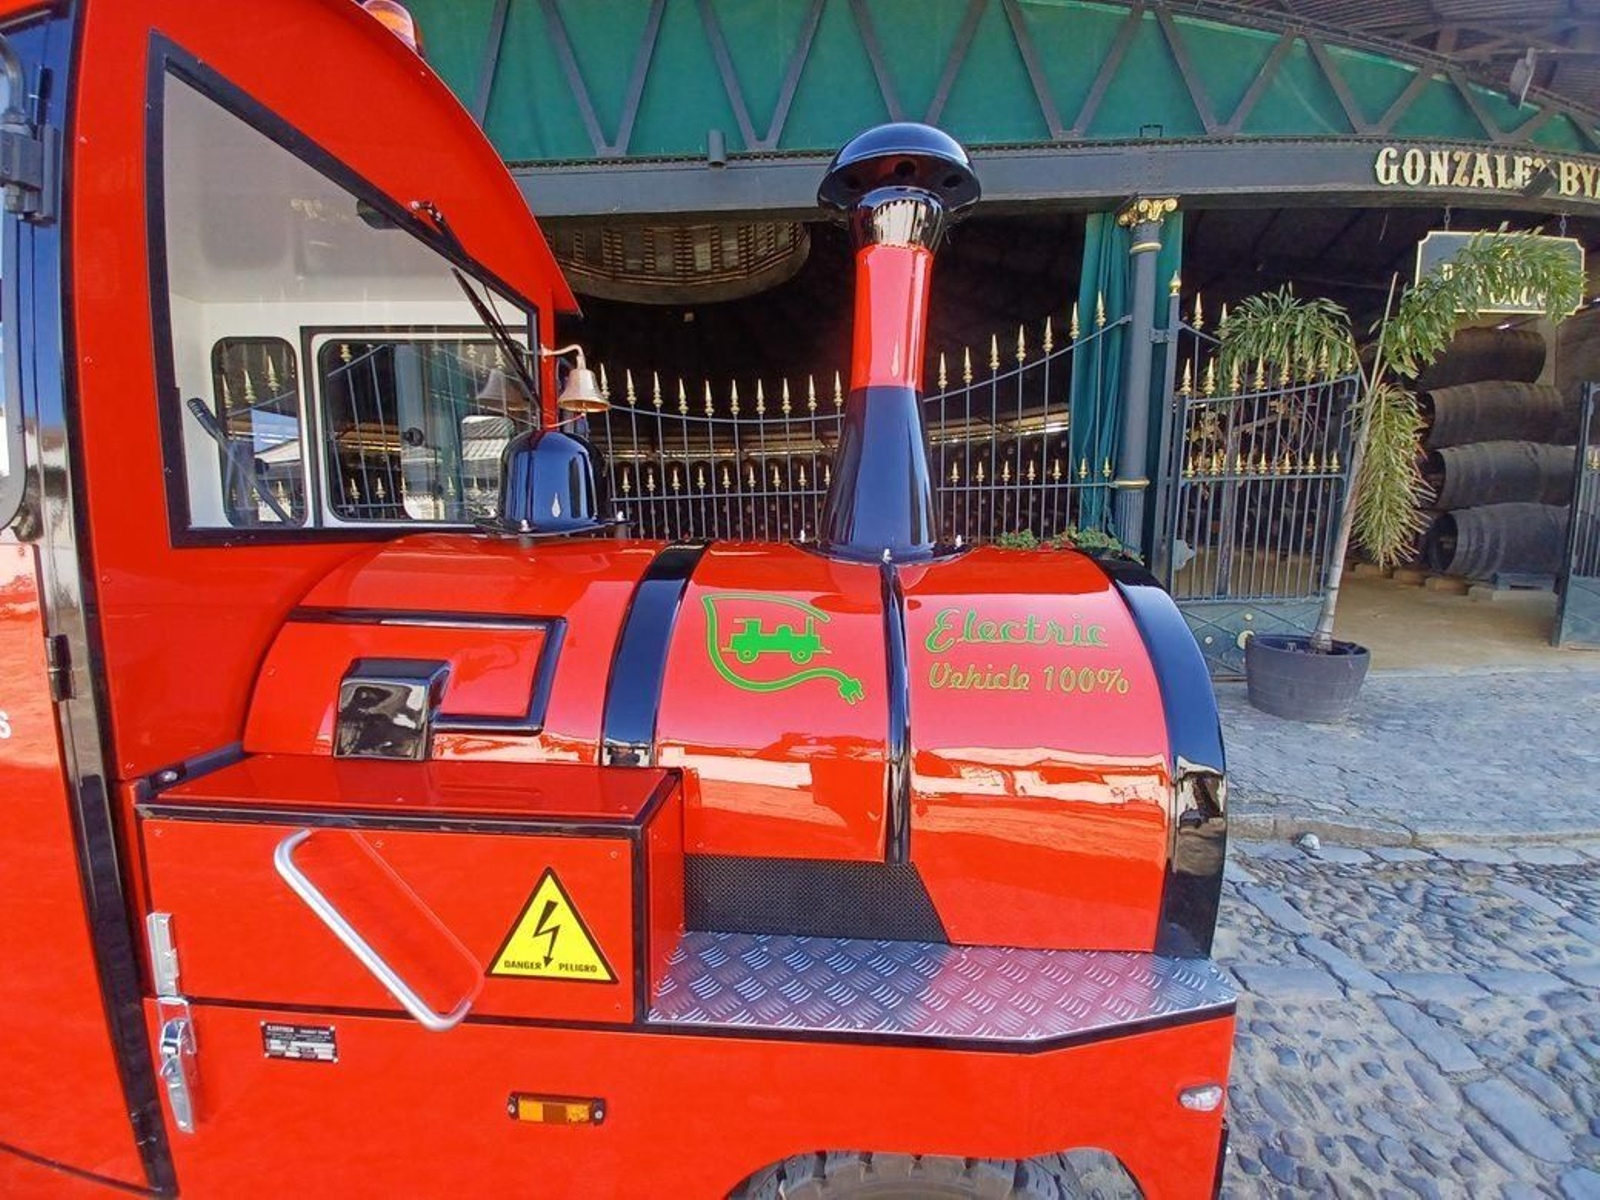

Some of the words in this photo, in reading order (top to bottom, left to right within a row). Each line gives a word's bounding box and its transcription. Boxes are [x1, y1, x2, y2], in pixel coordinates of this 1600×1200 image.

[1558, 159, 1600, 198] BY
[925, 607, 1108, 653] Electric
[929, 661, 1030, 690] Vehicle
[1043, 666, 1129, 693] 100%
[504, 960, 542, 970] DANGER
[558, 962, 597, 973] PELIGRO
